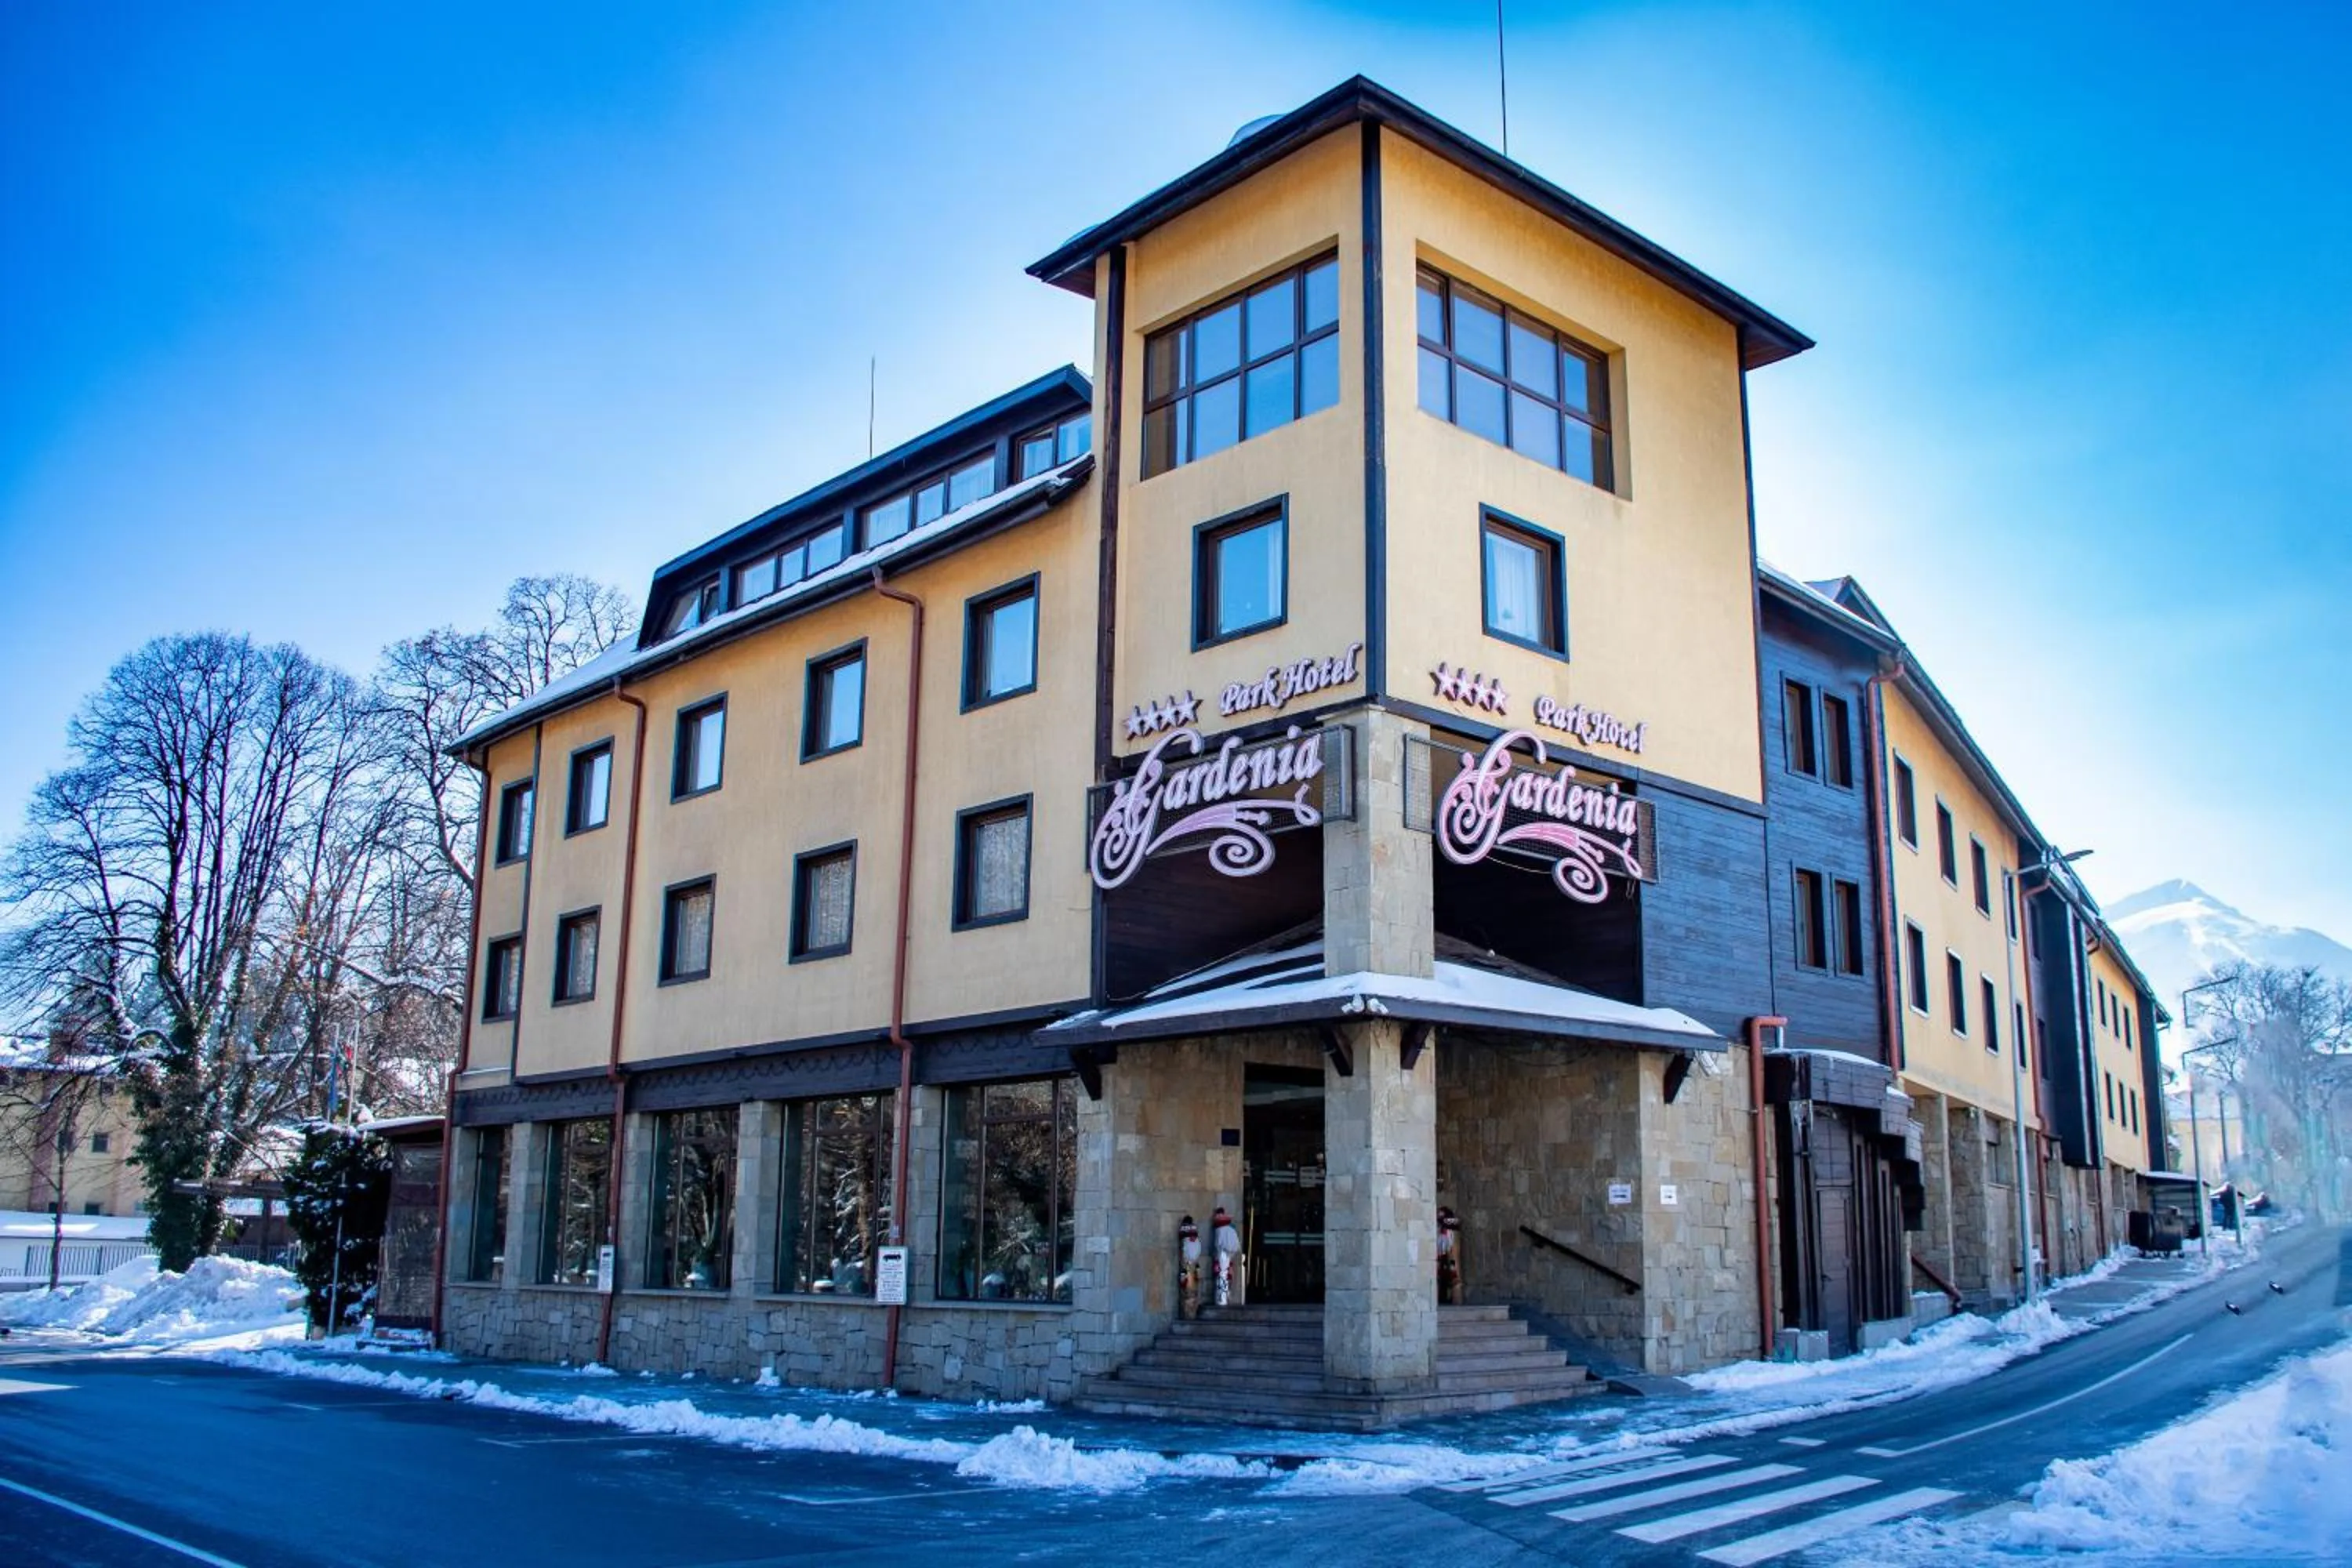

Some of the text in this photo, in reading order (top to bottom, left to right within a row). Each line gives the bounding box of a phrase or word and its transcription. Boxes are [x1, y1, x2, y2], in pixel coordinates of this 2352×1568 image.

[1220, 642, 1363, 717] Park Hotel
[1534, 695, 1648, 753] Park Hotel
[1091, 727, 1325, 889] Gardenia
[1437, 729, 1638, 864] Gardenia
